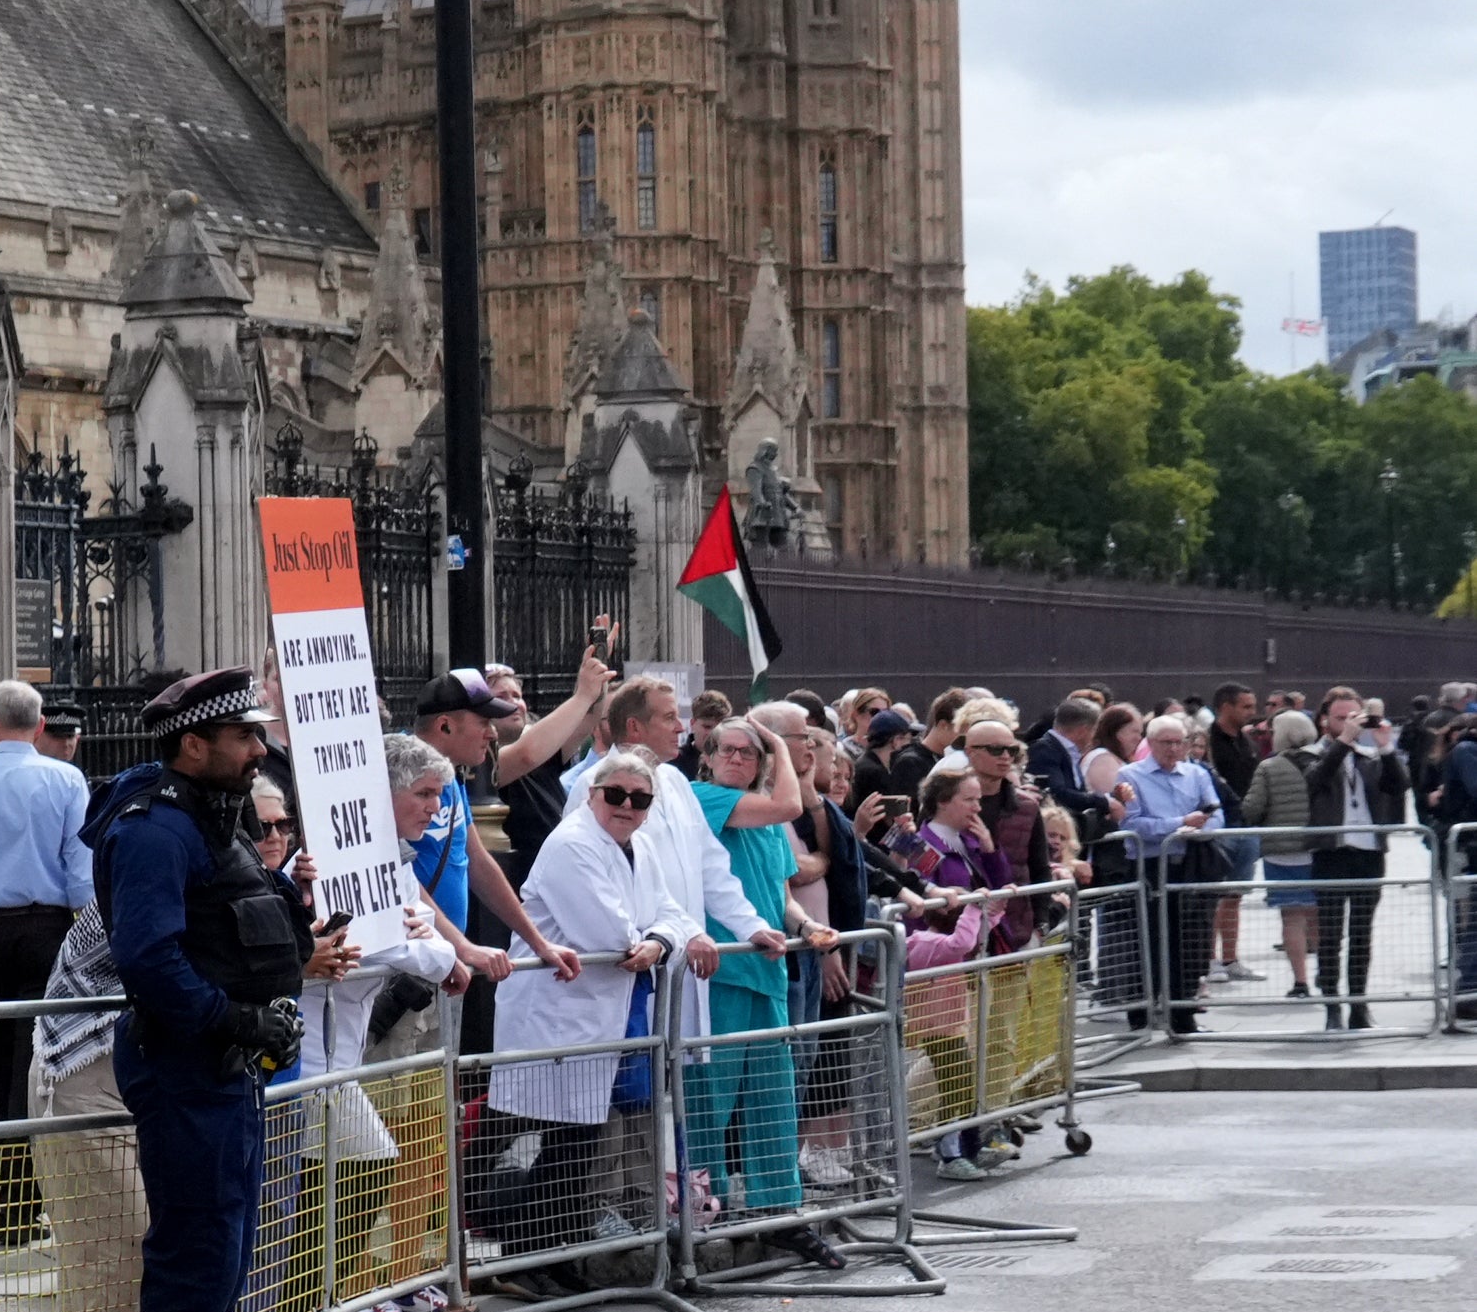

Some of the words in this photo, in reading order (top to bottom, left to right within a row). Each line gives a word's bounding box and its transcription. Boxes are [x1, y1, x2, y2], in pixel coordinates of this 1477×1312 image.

[272, 531, 300, 573] Just
[300, 530, 332, 584] Stop
[334, 529, 354, 571] Oil
[283, 637, 303, 669] ARE
[305, 633, 368, 666] ANNOYING...
[293, 693, 316, 725] BUT
[317, 688, 348, 722] THEY
[350, 685, 371, 716] ARE
[313, 743, 351, 776] TRYING
[352, 739, 367, 769] TO
[330, 797, 372, 851] SAVE
[321, 867, 368, 919] YOUR
[371, 861, 403, 913] LIFE
